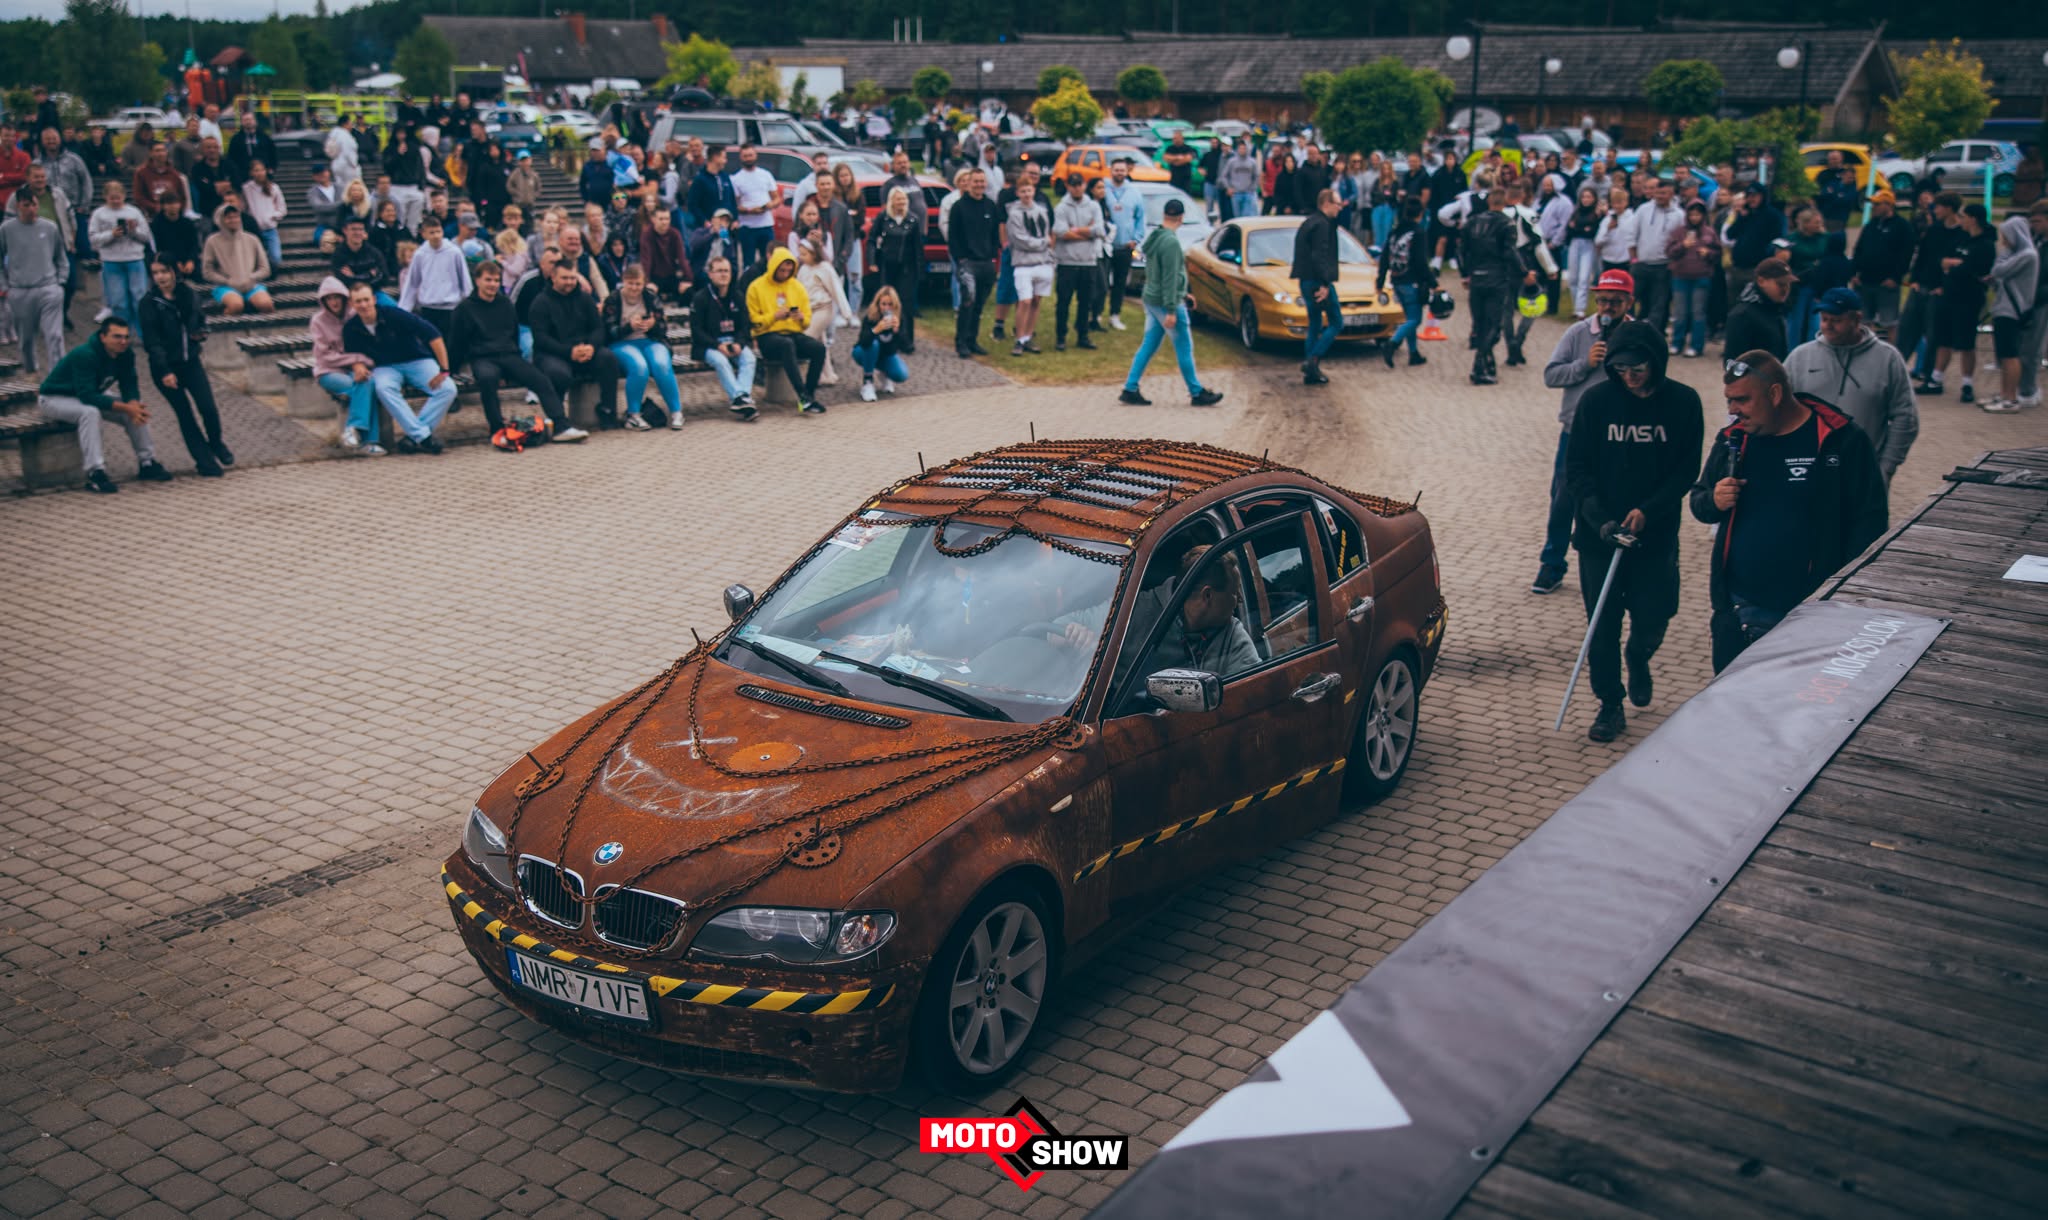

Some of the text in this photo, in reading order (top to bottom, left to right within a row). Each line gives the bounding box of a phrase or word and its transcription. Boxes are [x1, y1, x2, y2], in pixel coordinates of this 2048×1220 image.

[1607, 423, 1667, 442] NASA
[519, 957, 639, 1014] NMR 71VF
